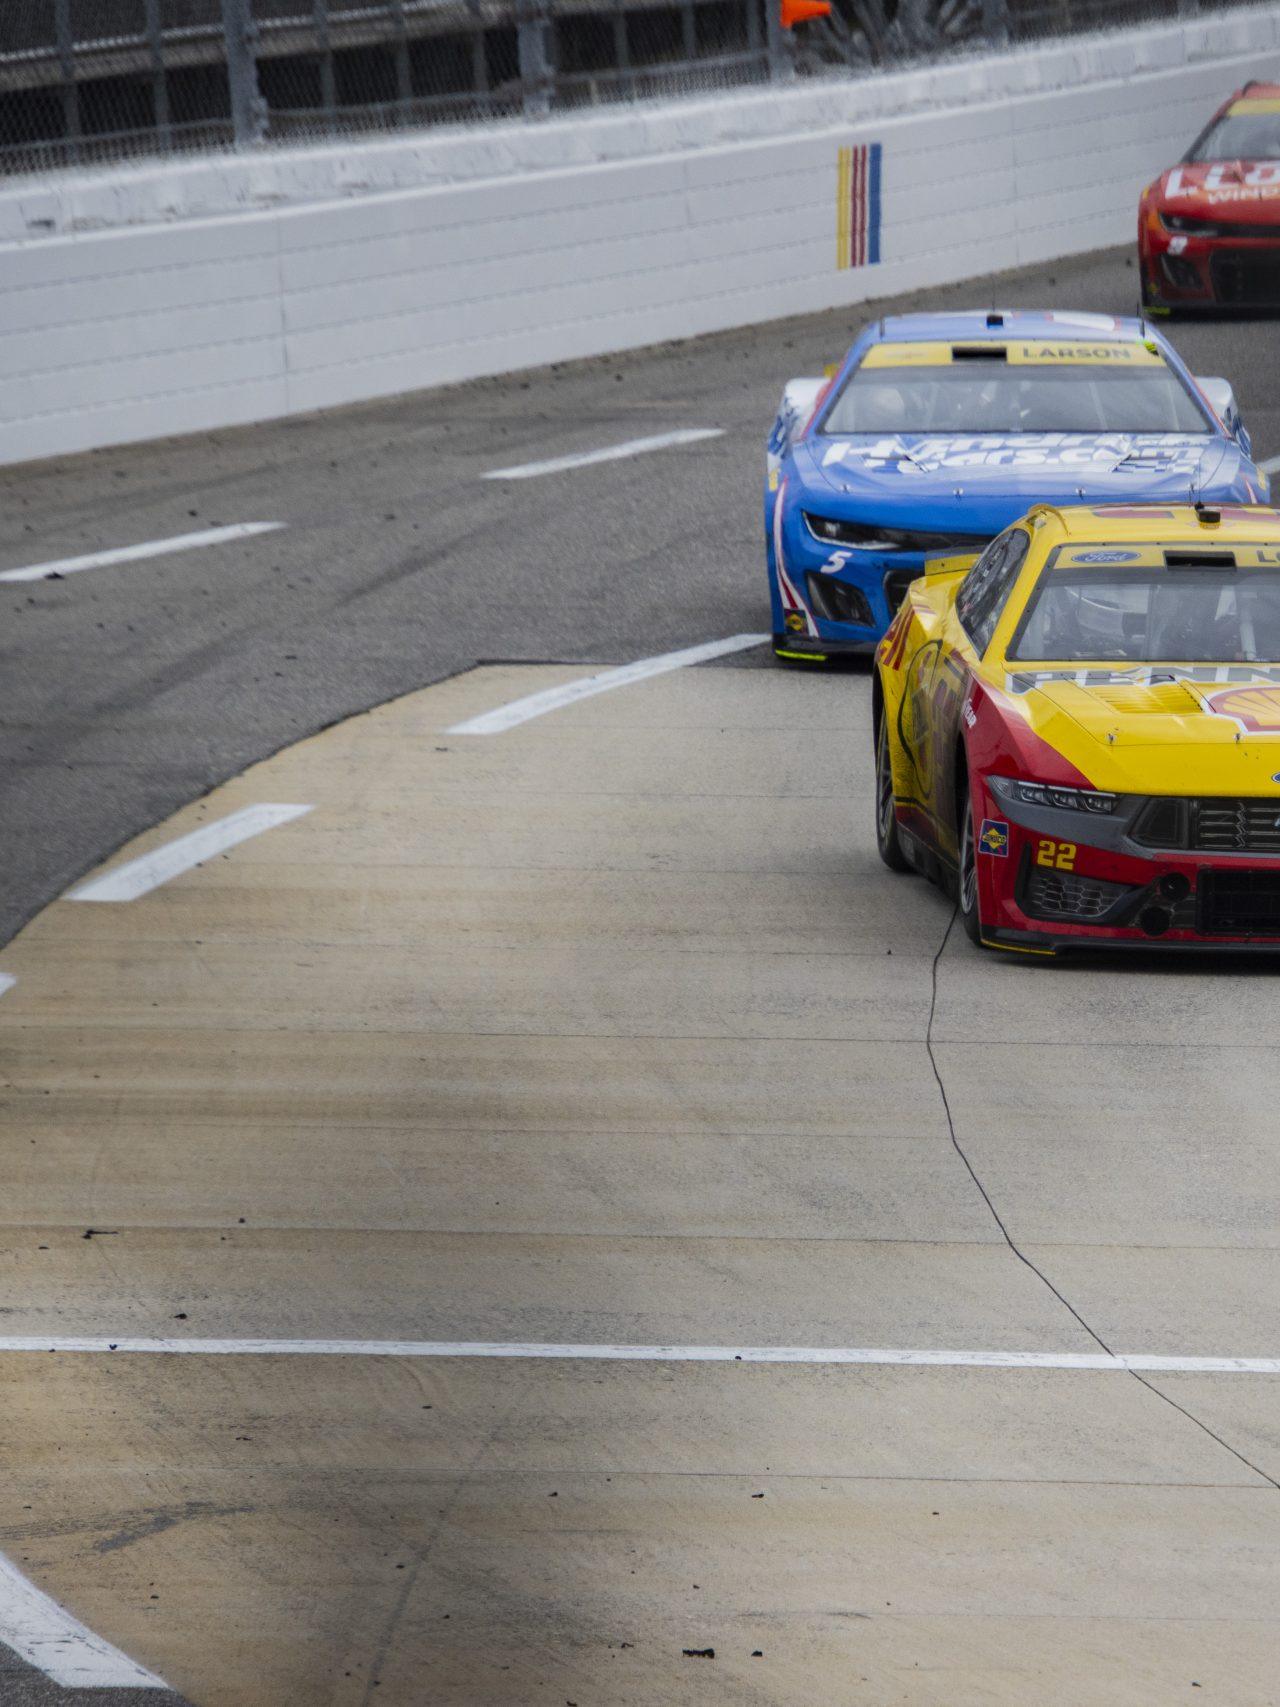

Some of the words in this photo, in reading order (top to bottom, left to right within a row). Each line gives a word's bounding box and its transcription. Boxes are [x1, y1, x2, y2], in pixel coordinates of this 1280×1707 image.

[1023, 347, 1131, 359] LARSON
[820, 550, 853, 574] 5
[1037, 840, 1077, 870] 22
